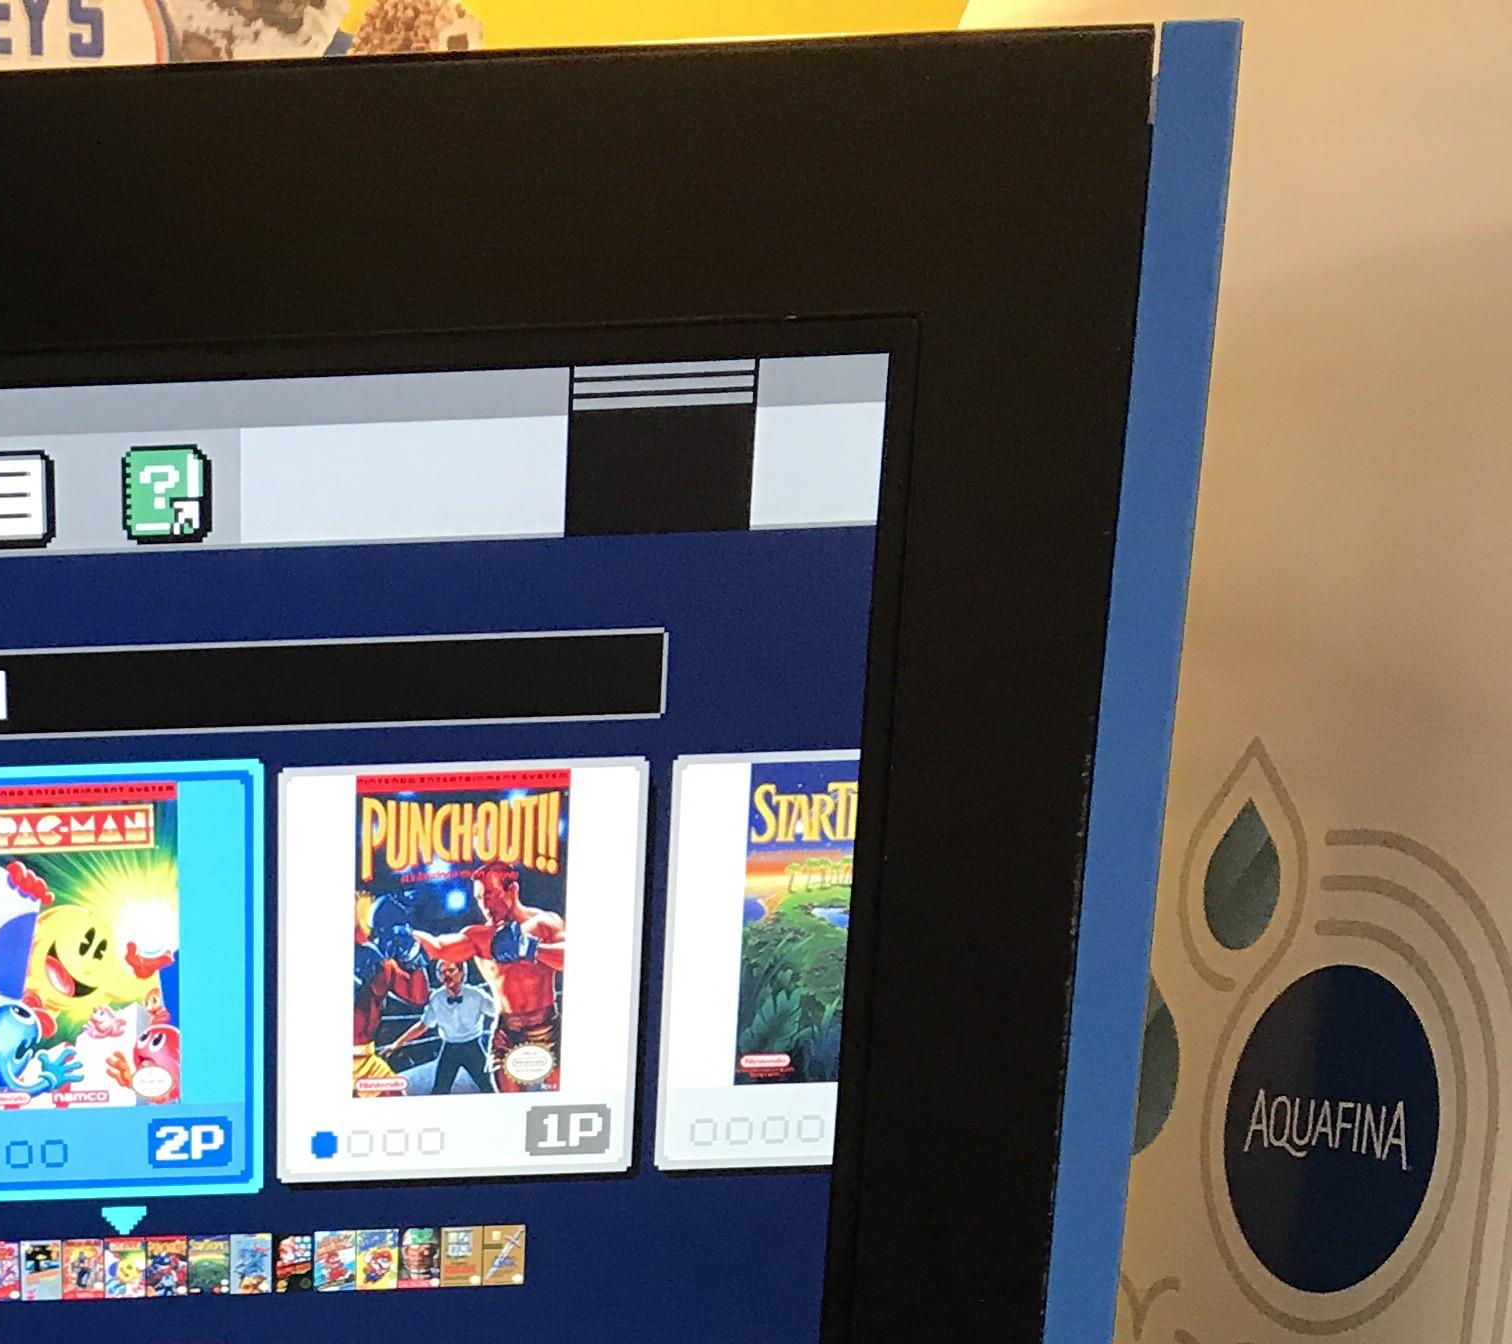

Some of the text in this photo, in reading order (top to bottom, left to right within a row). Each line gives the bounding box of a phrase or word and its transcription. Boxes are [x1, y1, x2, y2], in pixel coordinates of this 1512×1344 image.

[155, 1125, 225, 1162] 2P
[537, 1113, 604, 1149] 1P
[1243, 1088, 1410, 1171] AQUAFINA
